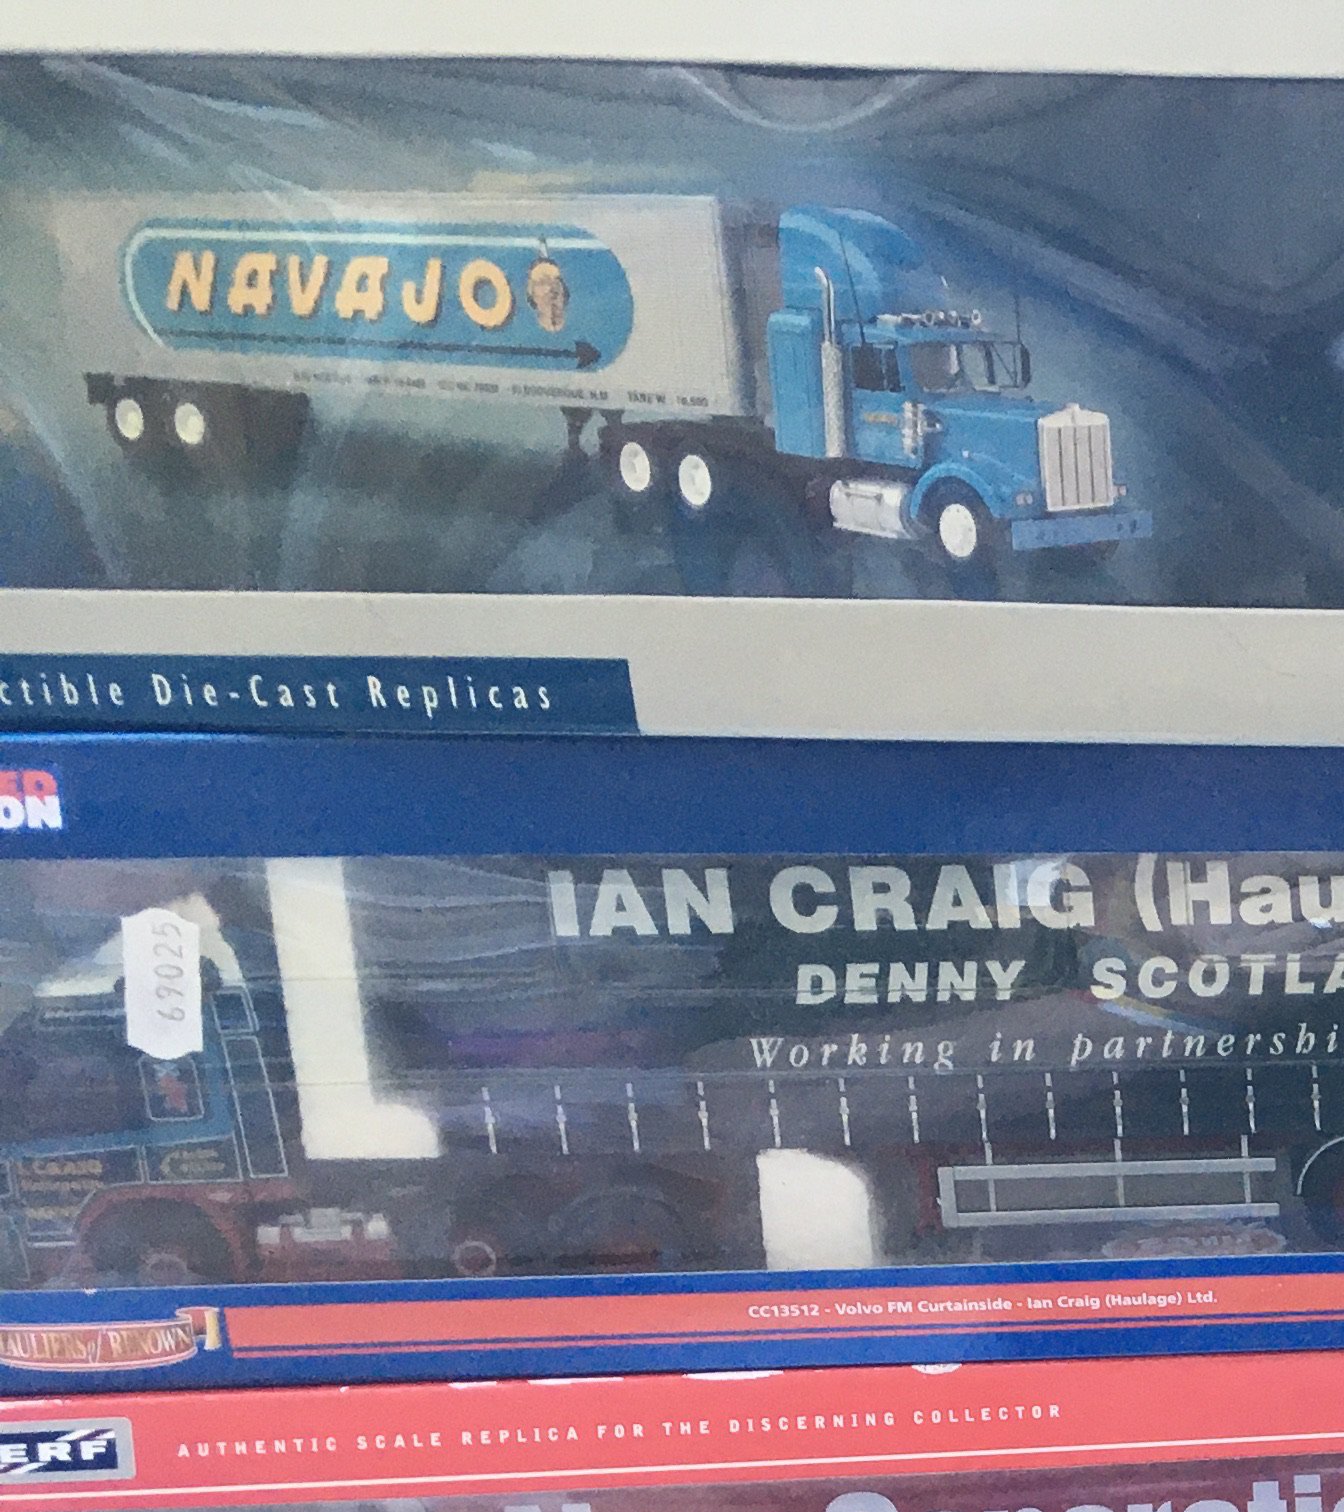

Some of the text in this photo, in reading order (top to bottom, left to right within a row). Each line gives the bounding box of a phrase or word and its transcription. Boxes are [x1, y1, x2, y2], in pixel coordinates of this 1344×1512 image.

[166, 250, 514, 328] NAVAJO
[153, 674, 553, 719] Die-Cast Replicas
[548, 867, 735, 938] IAN
[769, 861, 1097, 933] CRAIG
[796, 961, 1027, 1005] DENNY
[750, 1034, 957, 1071] Working
[988, 1031, 1036, 1062] in
[749, 1289, 1219, 1319] CC13512 Volvo FM Curtainside Ian Craig (Haulage) Ltd.
[177, 1404, 1062, 1458] AUTHENTIC SCALE REPLICA FOR THE DISCERNING COLLECTOR
